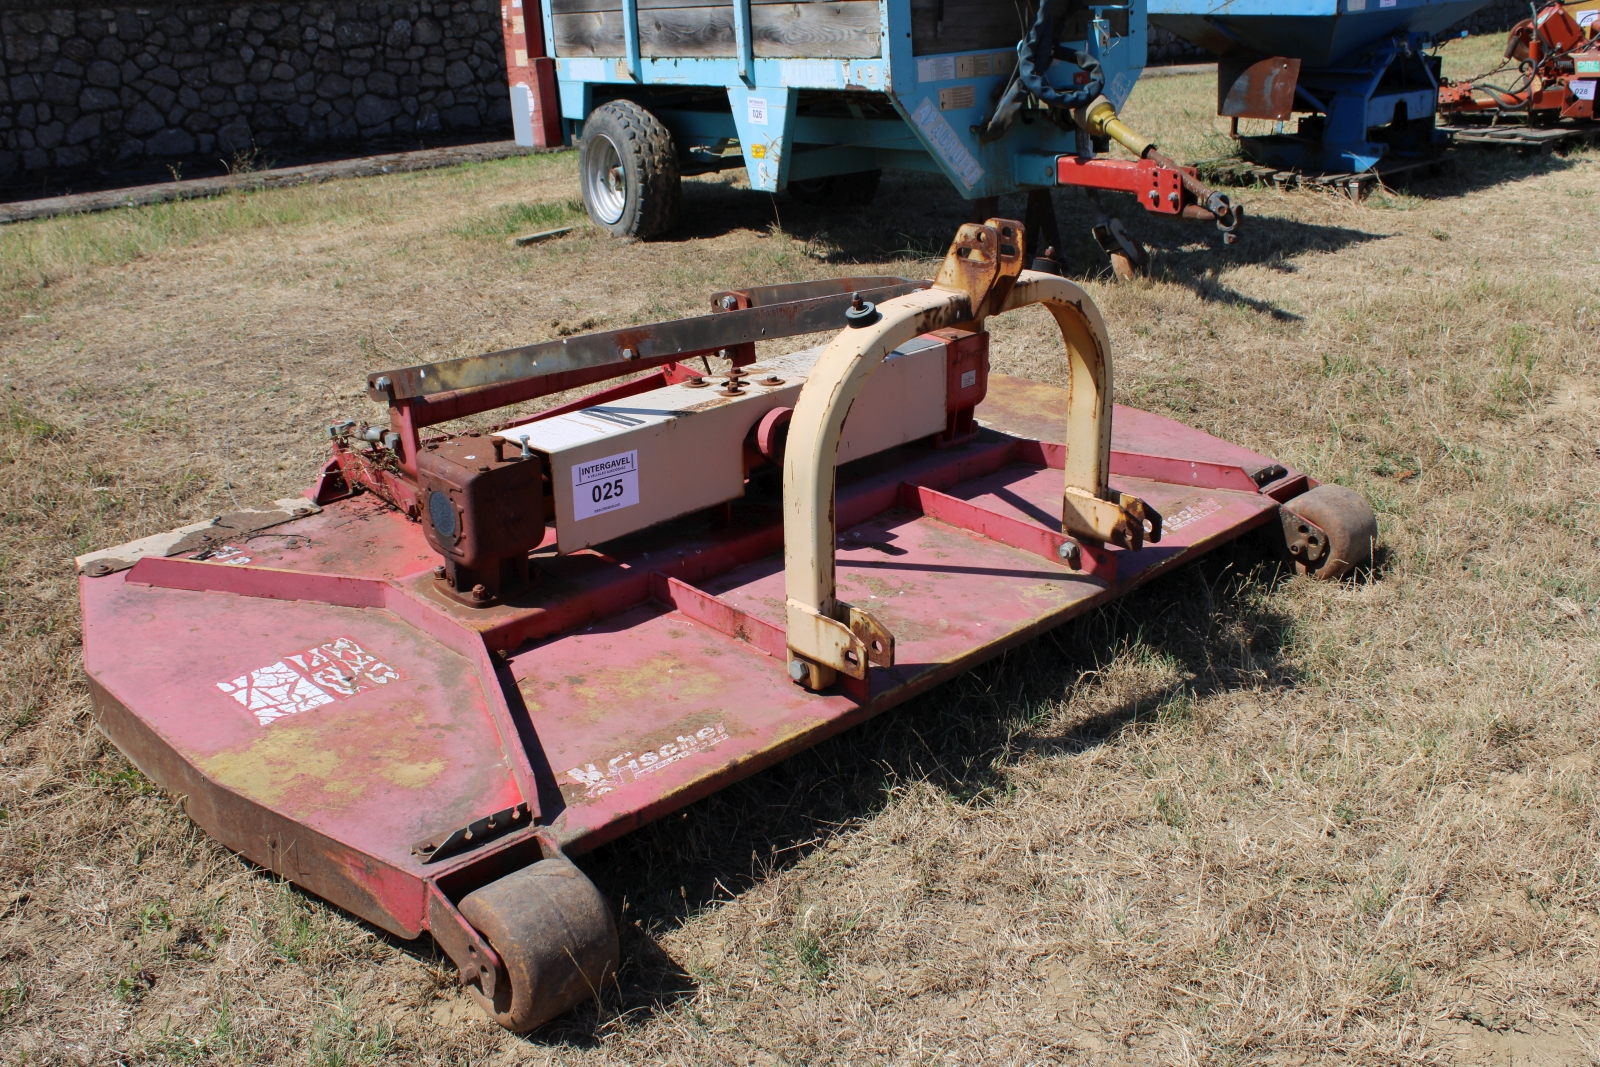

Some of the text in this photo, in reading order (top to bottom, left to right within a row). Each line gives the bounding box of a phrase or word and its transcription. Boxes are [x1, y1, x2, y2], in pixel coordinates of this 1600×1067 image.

[752, 109, 762, 119] 026
[581, 456, 630, 475] INTERGAVEL
[592, 478, 624, 503] 025
